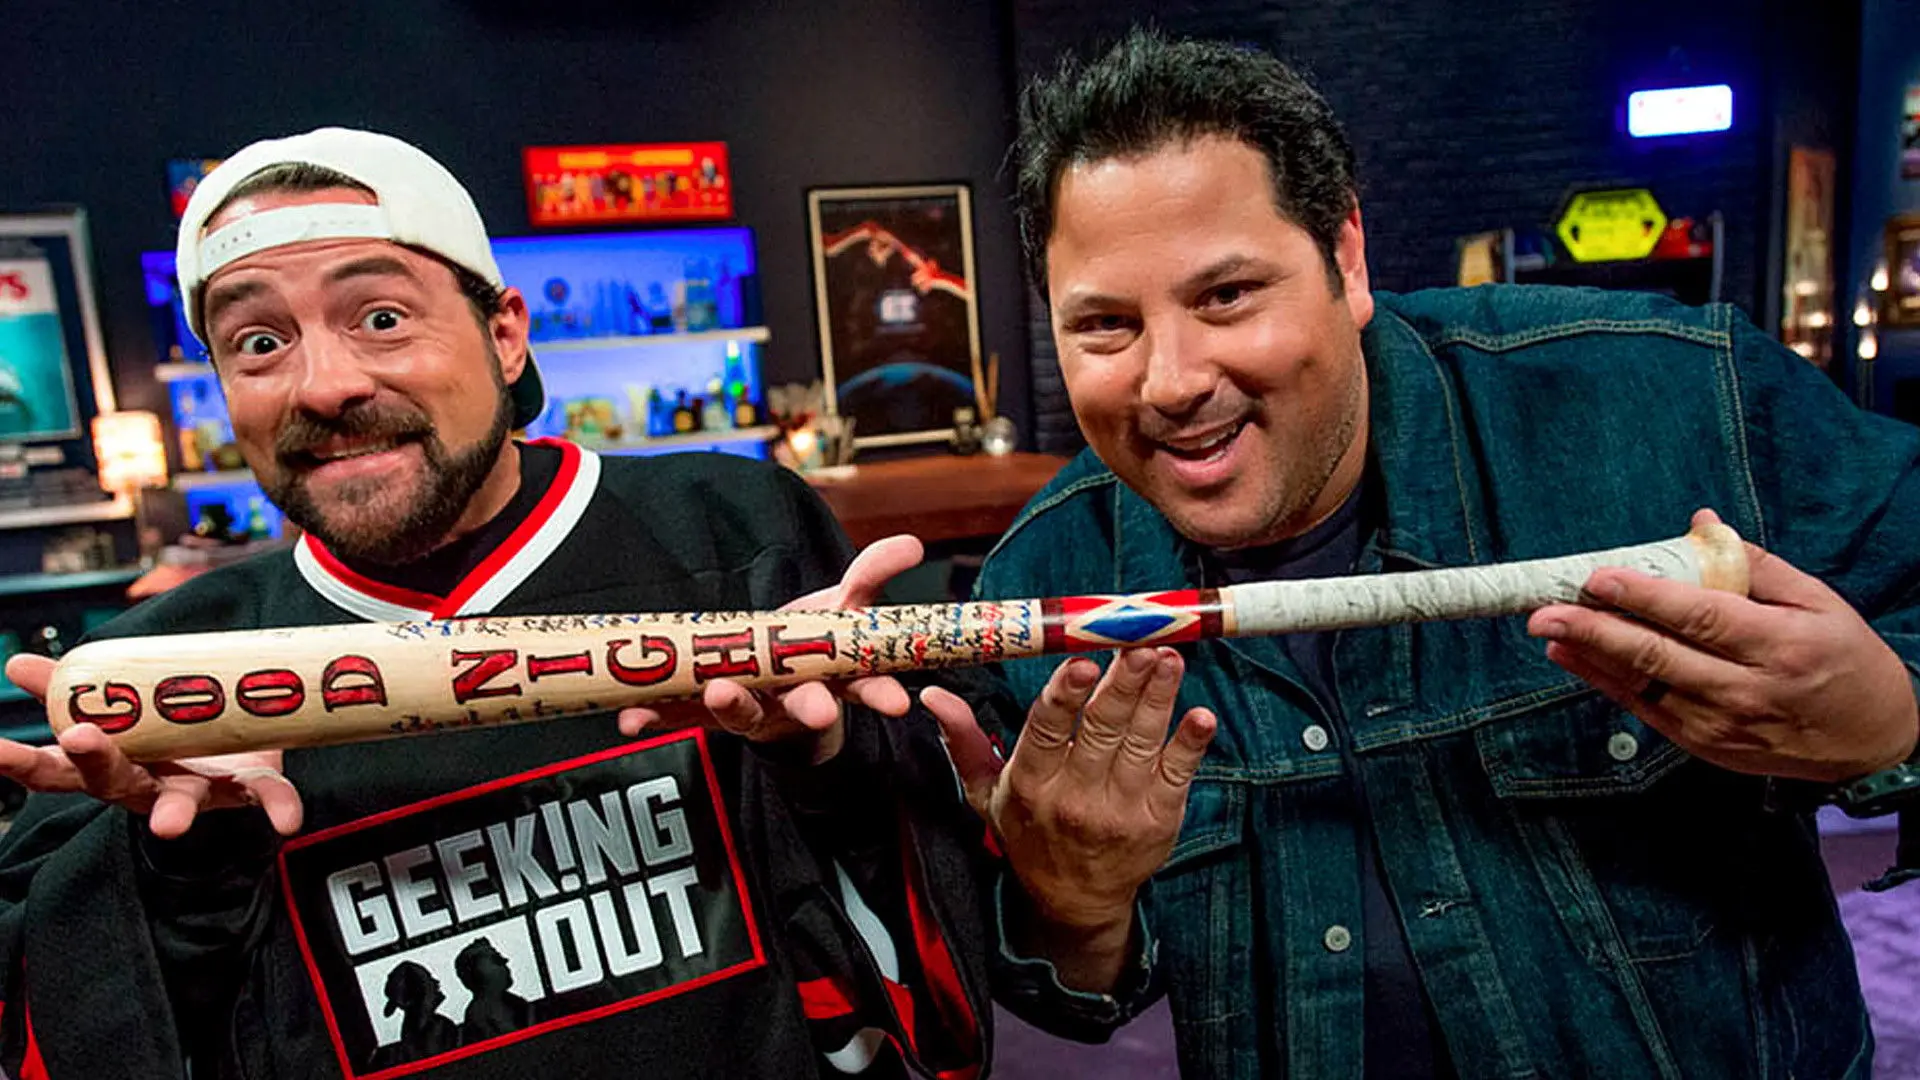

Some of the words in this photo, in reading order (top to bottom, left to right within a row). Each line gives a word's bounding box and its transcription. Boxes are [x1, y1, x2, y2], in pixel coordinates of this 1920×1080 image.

[69, 654, 388, 735] GOOD
[452, 624, 837, 704] NIGHT
[535, 864, 701, 994] OUT
